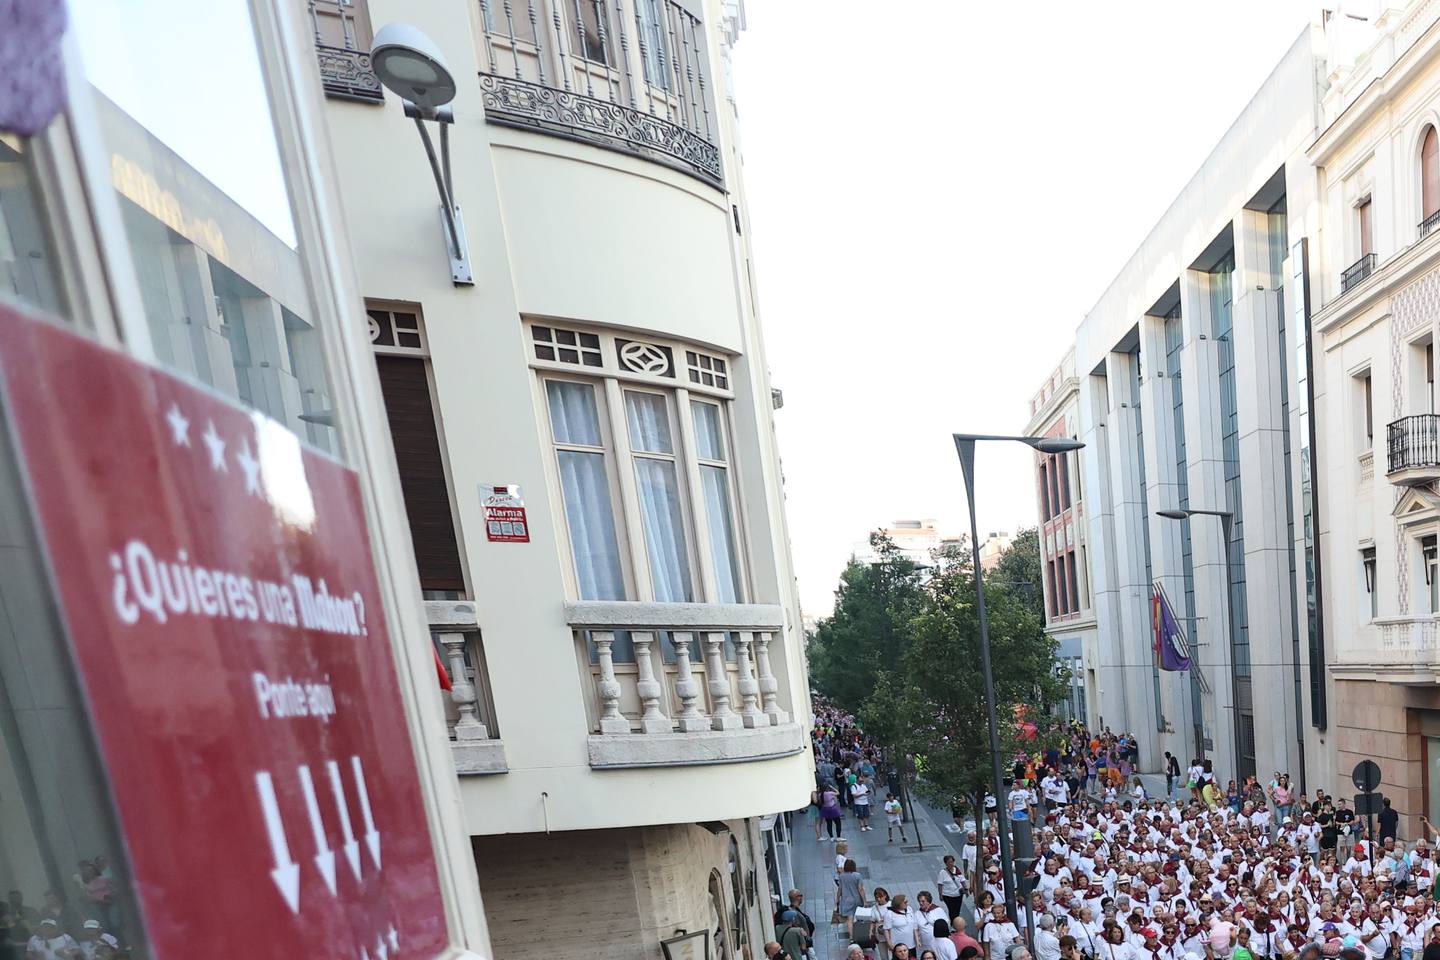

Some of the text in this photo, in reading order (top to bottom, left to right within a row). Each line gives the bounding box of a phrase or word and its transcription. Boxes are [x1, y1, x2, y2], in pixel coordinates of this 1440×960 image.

[486, 508, 523, 517] Alarma
[110, 539, 260, 624] ¿Quieres
[257, 580, 299, 628] una
